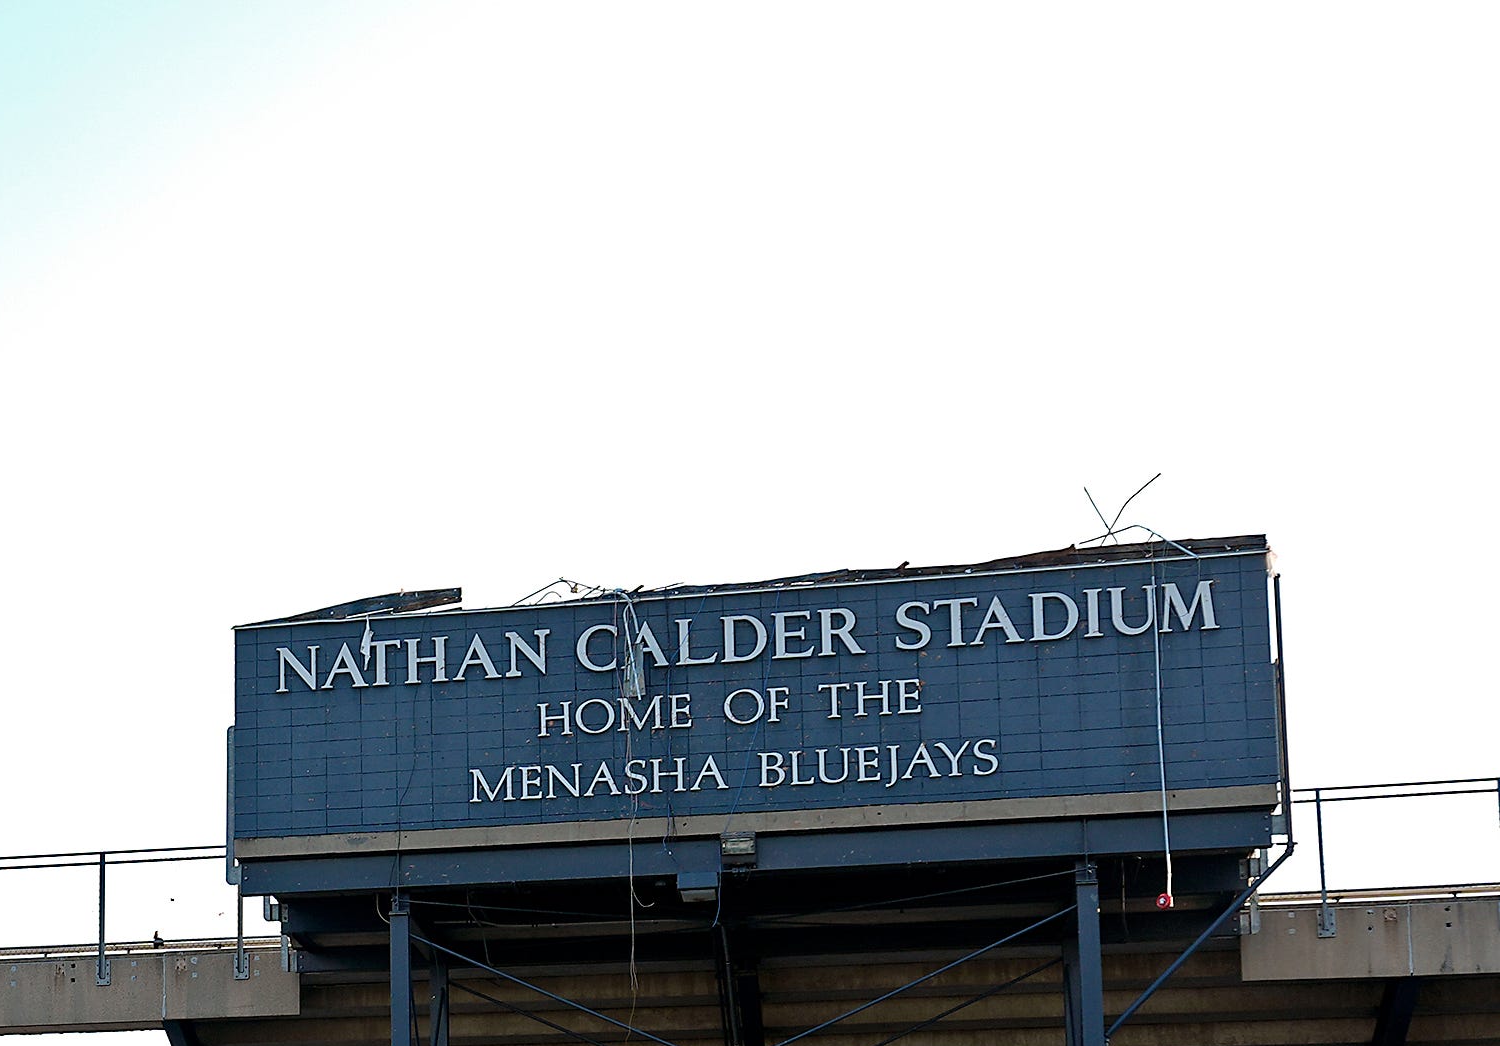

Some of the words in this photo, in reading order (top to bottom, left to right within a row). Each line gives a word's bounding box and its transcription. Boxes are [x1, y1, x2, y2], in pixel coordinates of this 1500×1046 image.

[276, 629, 550, 693] NATHAN
[576, 608, 866, 673] CALDER
[895, 580, 1220, 650] STADIUM
[537, 693, 692, 737] HOME
[723, 686, 789, 725] OF
[817, 678, 922, 719] THE
[469, 755, 729, 802] MENASHA
[757, 739, 999, 788] BLUEJAYS
